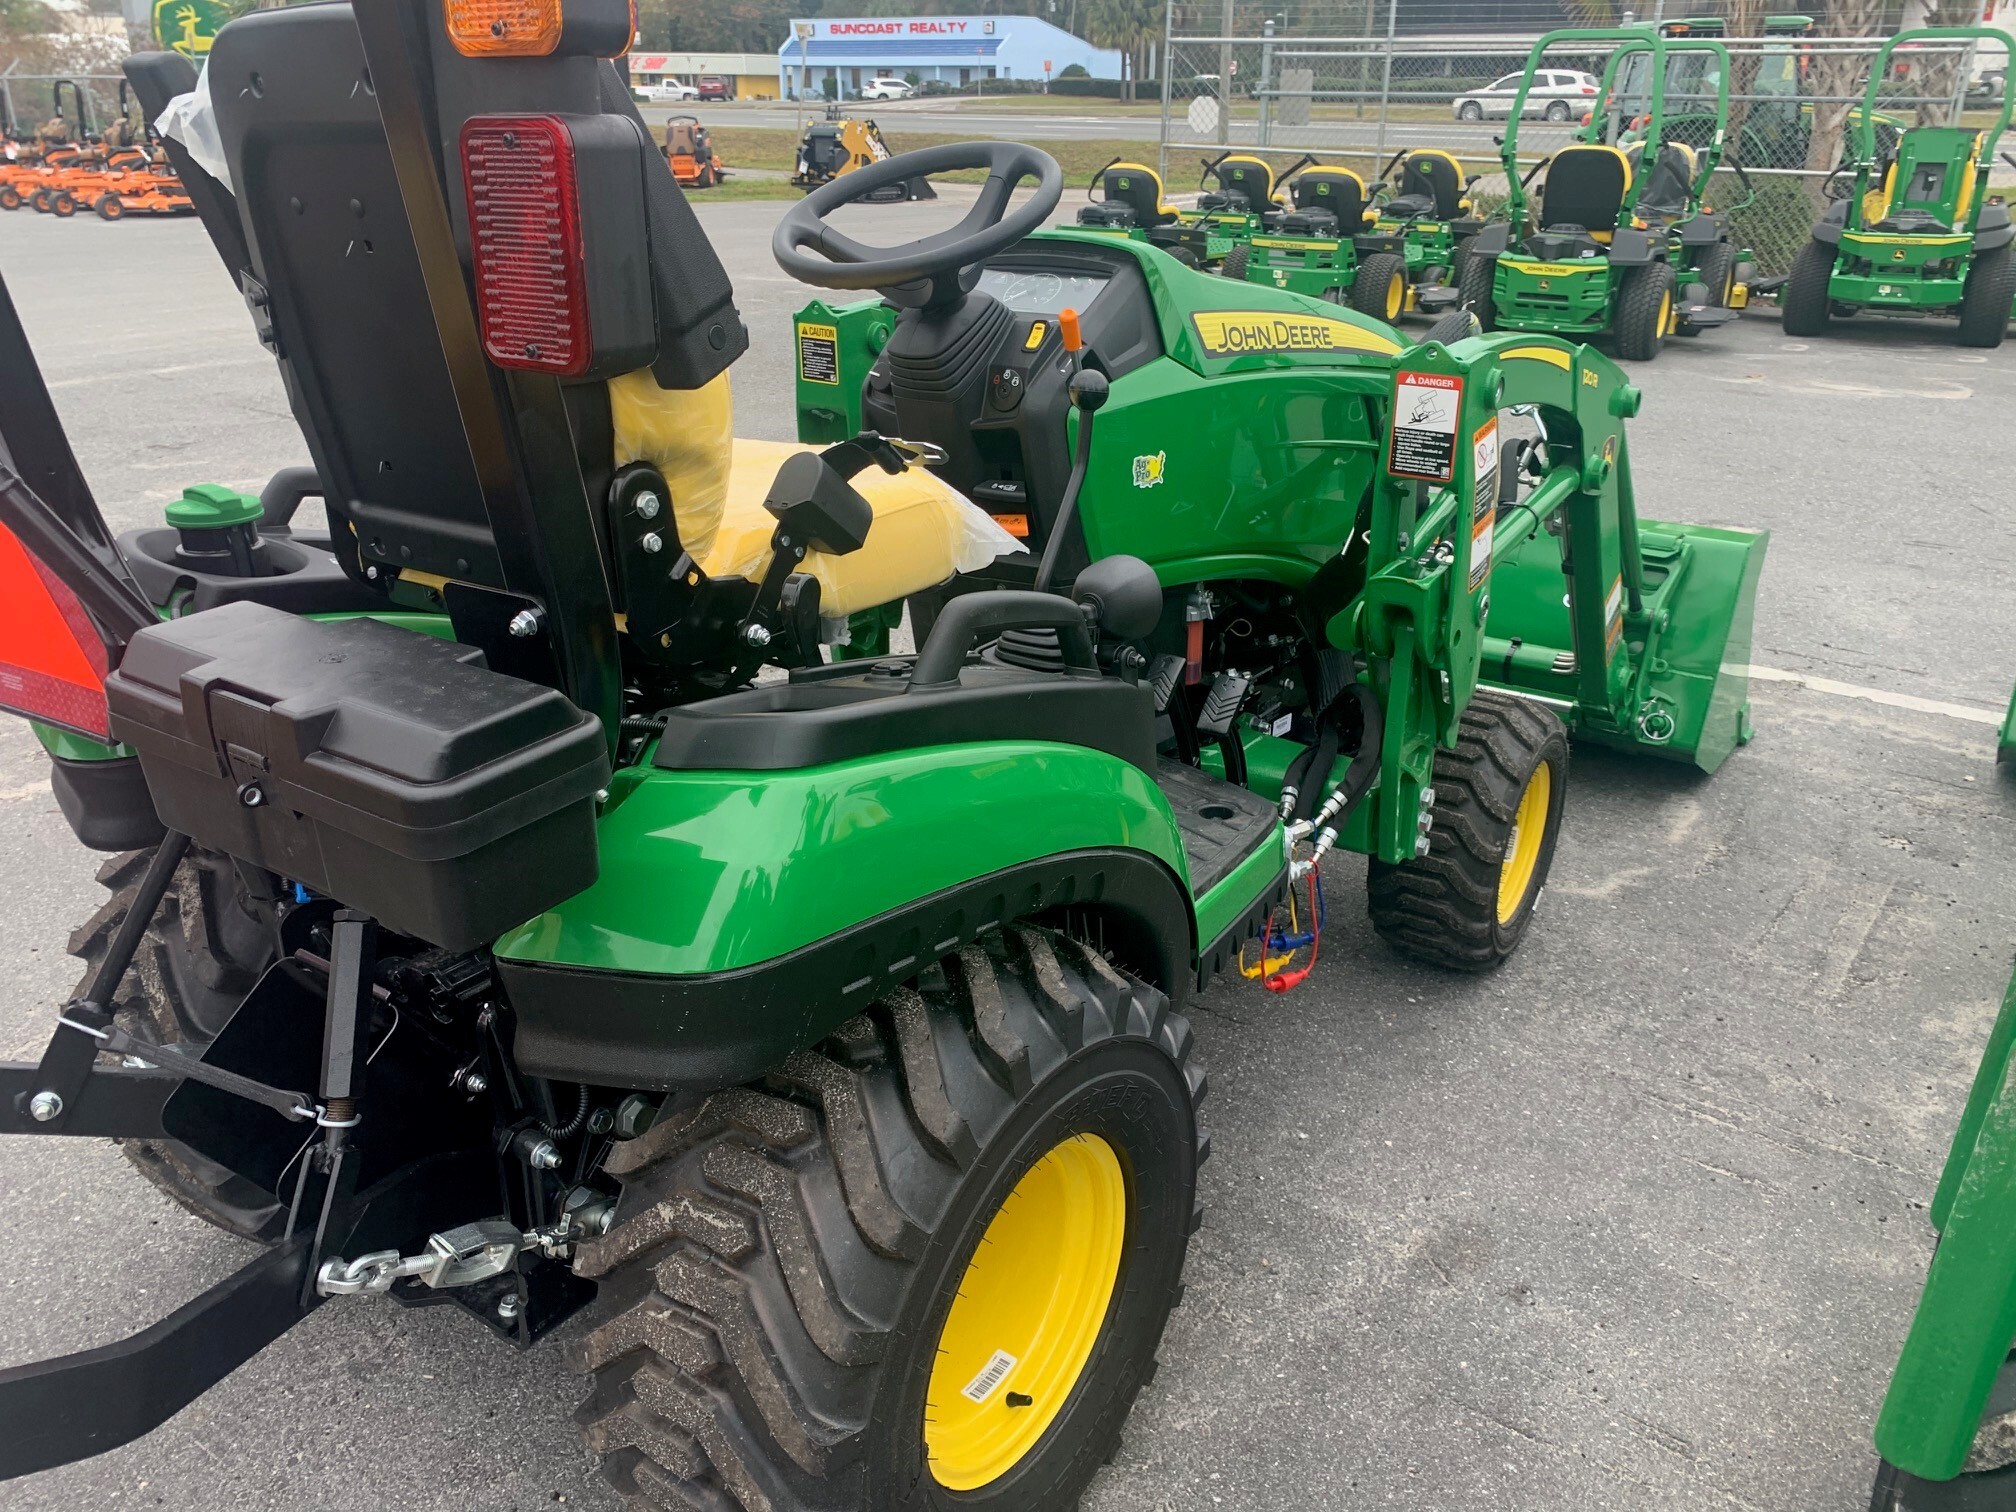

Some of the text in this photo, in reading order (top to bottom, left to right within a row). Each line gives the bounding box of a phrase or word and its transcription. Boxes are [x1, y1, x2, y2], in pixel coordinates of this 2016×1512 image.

[830, 22, 967, 34] SUNCOAST REALTY
[1544, 266, 1567, 274] DEERE
[809, 326, 835, 338] CAUTION
[1217, 321, 1333, 348] JOHN DEERE
[1418, 377, 1454, 388] DANGER
